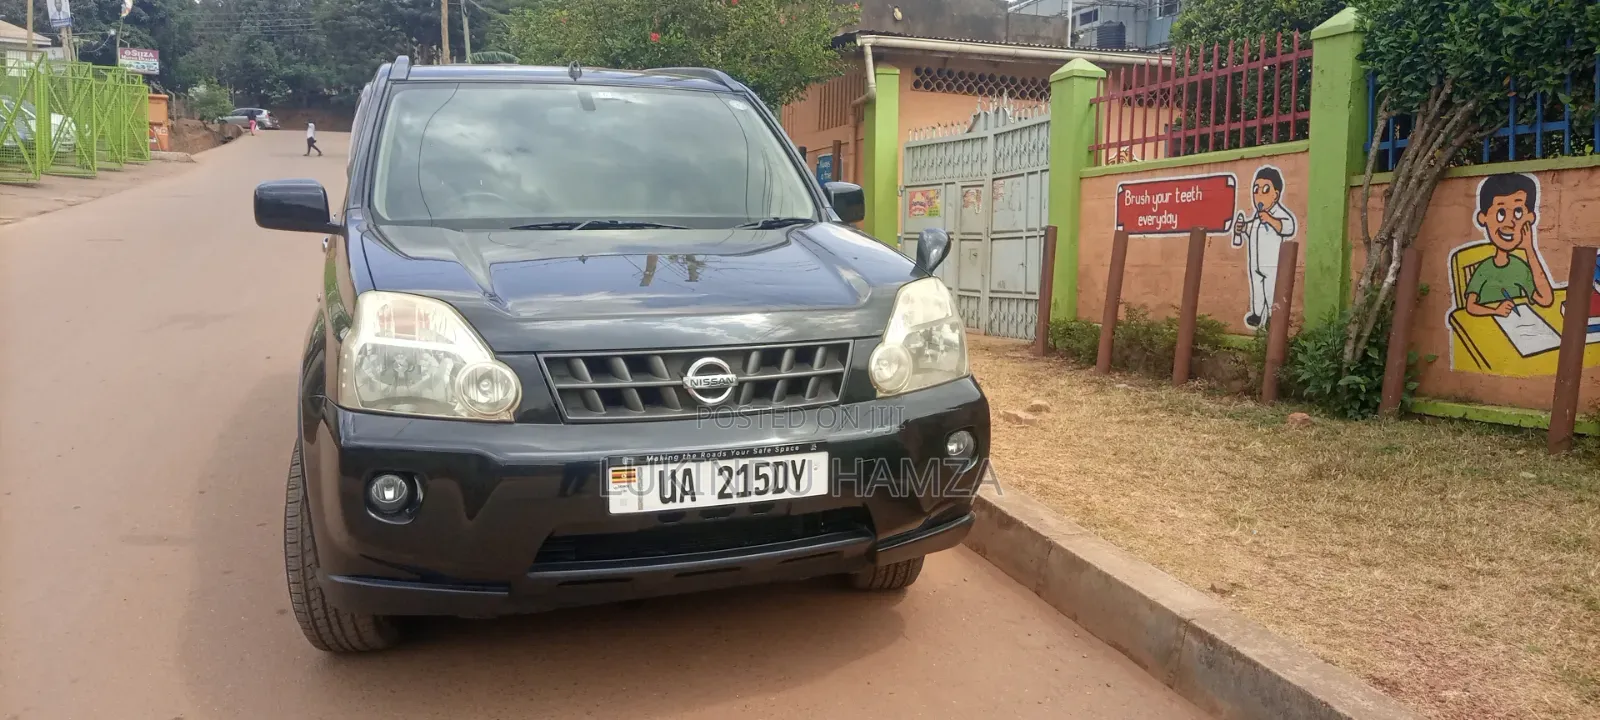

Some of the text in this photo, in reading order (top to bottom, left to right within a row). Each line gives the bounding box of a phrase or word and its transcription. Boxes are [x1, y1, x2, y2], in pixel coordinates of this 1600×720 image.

[1124, 185, 1203, 213] Brush your teeth
[1137, 209, 1178, 231] everyday
[690, 377, 734, 388] NISSAN
[646, 454, 679, 463] Making
[682, 452, 697, 460] the
[700, 450, 727, 458] Roads
[753, 447, 772, 455] Safe
[775, 444, 800, 453] Space
[658, 458, 807, 505] UA 215DY
